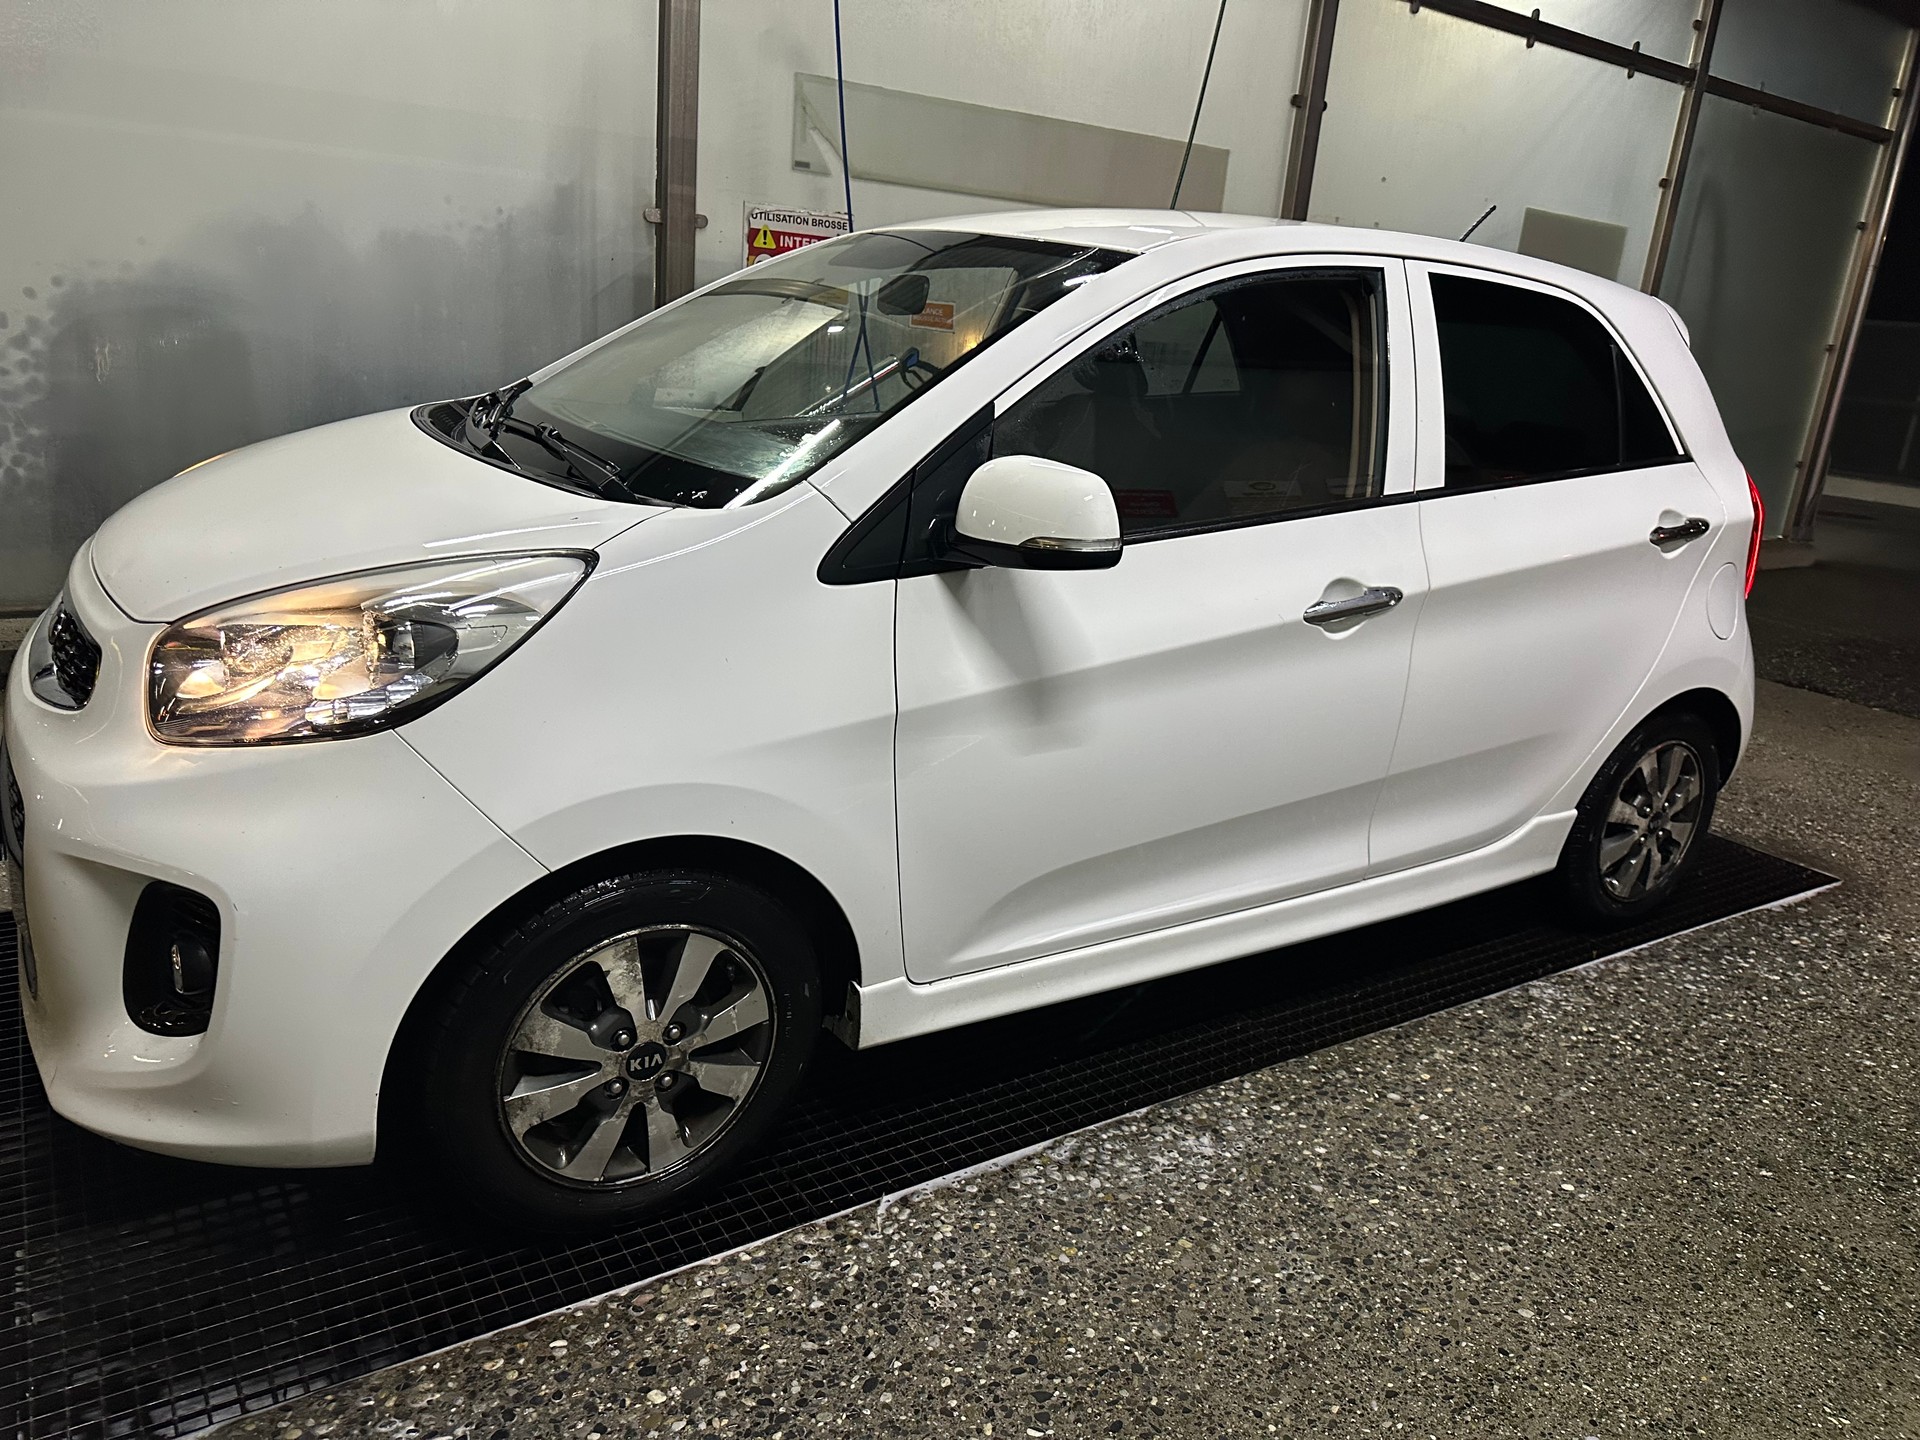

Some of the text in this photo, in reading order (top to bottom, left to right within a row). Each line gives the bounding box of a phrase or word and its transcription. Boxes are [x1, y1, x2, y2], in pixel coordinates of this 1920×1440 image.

[751, 212, 848, 231] UTILISATION BROSSE
[630, 1053, 663, 1072] KIA
